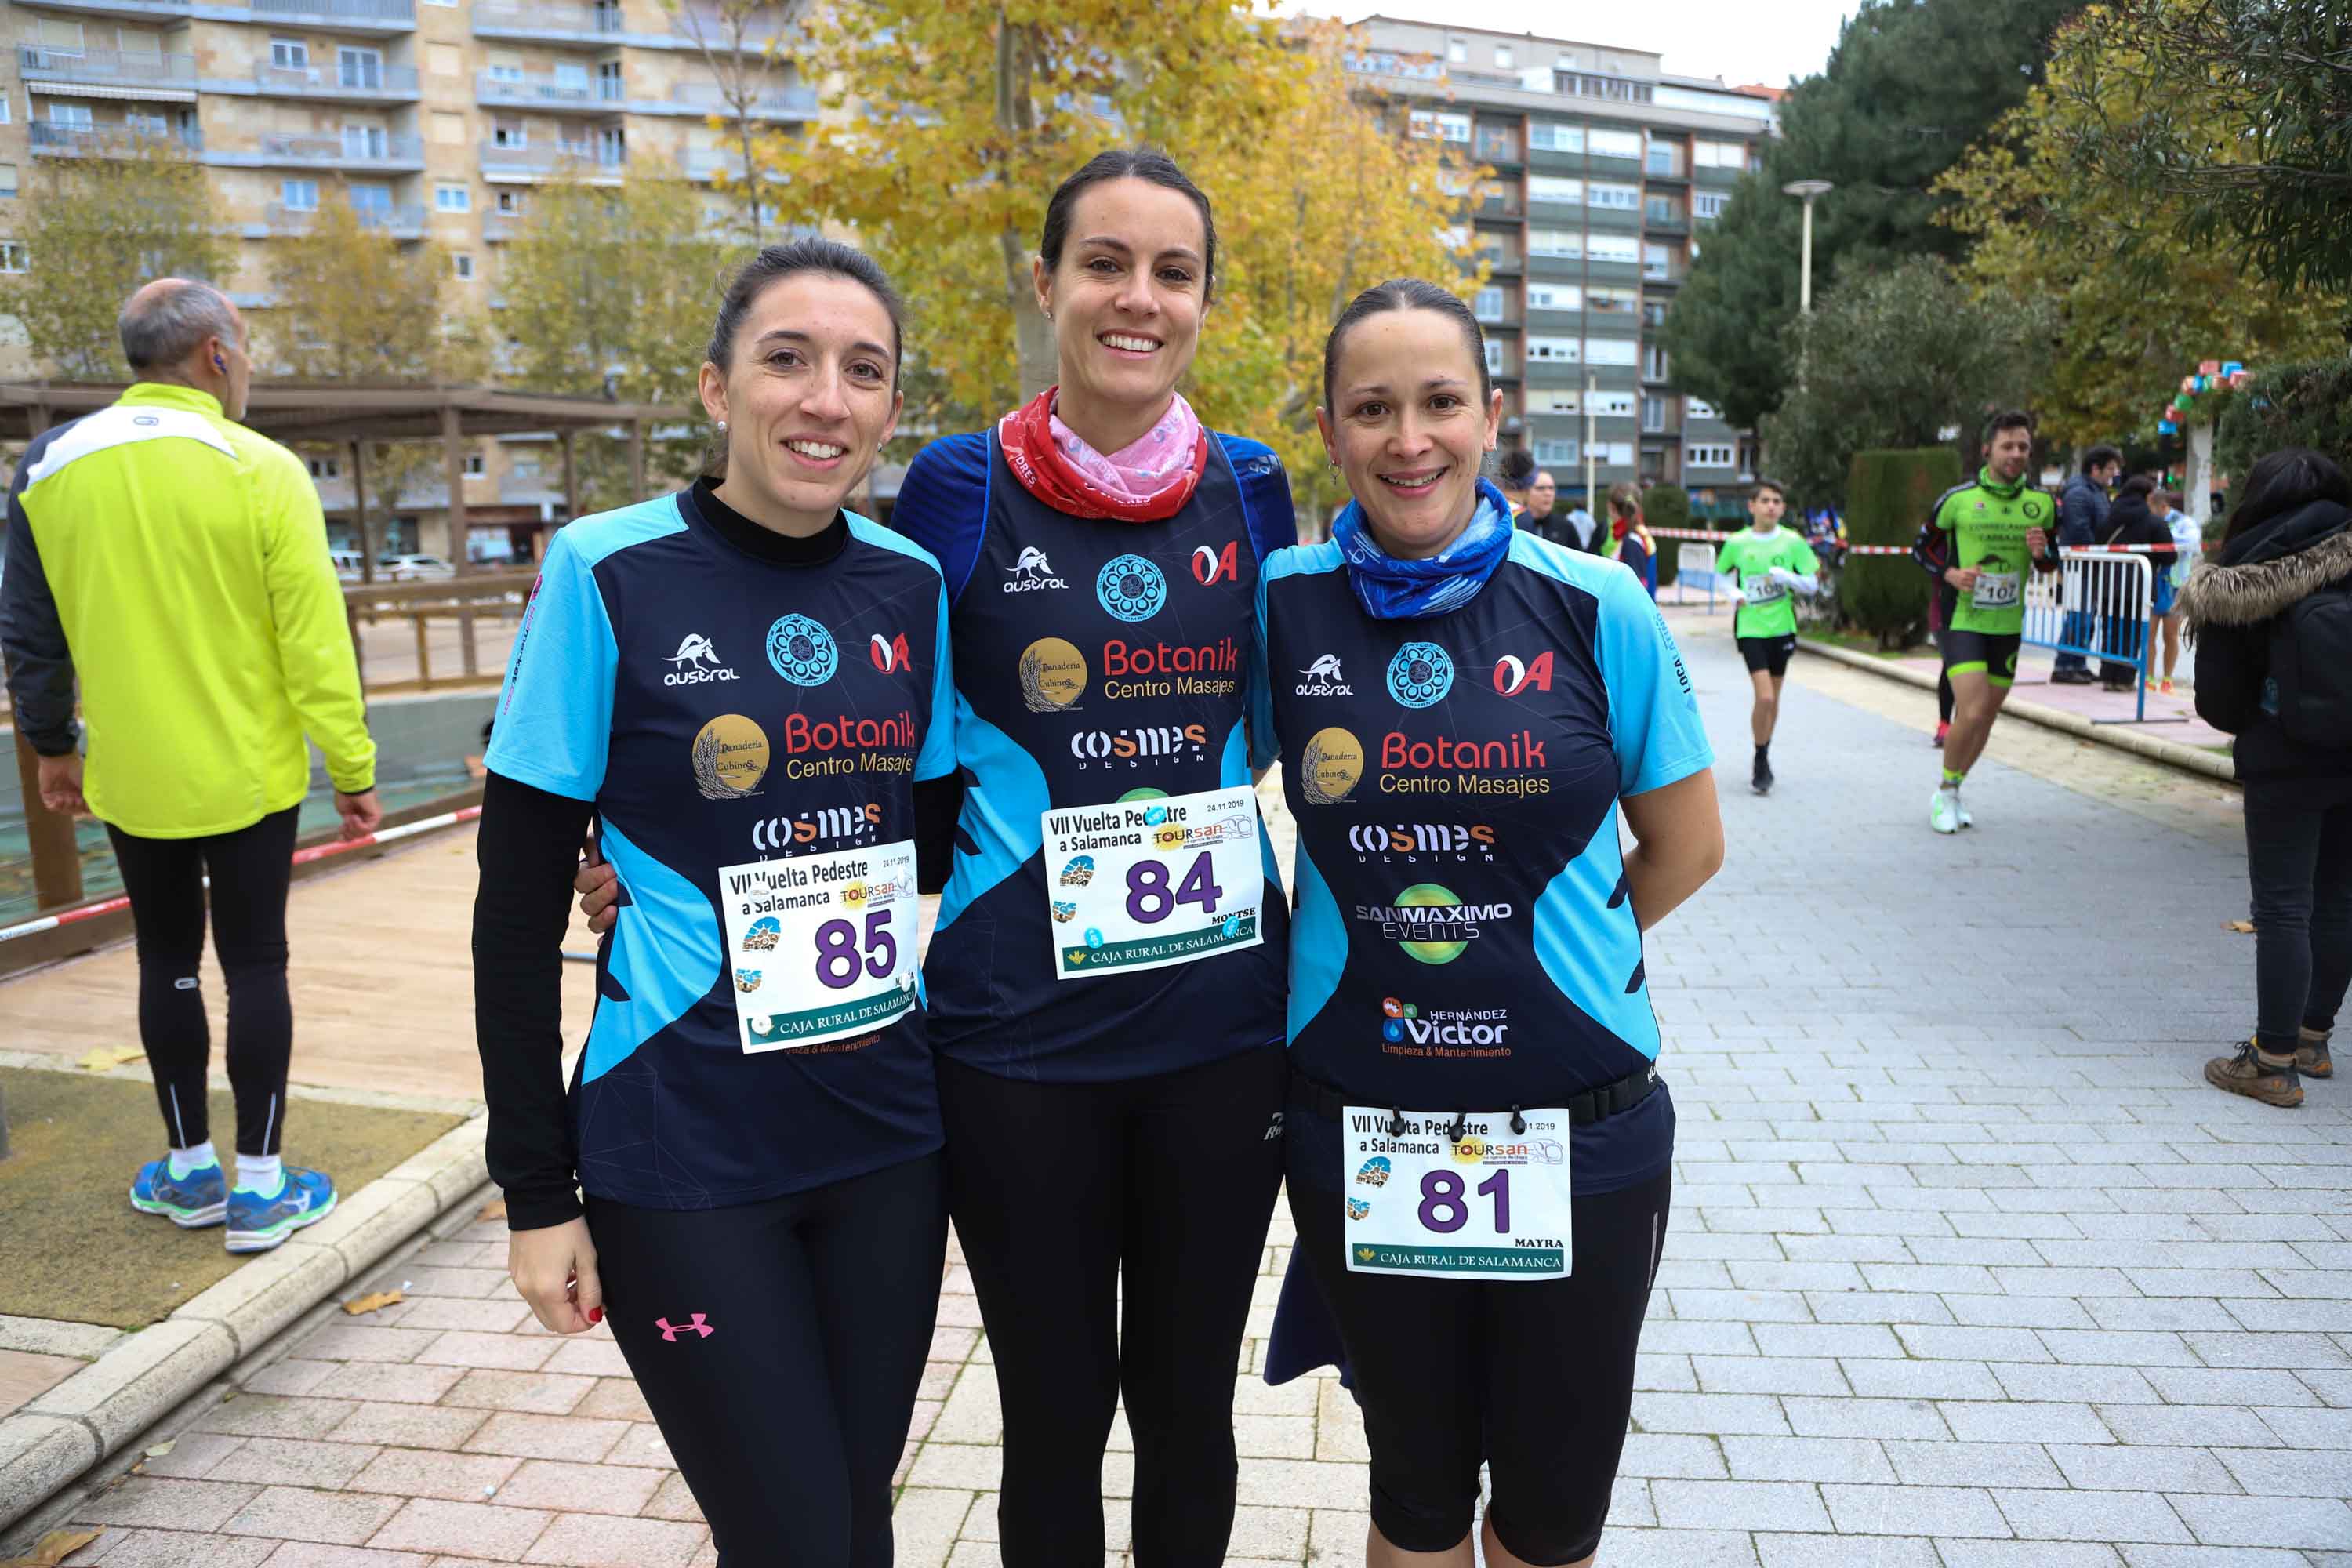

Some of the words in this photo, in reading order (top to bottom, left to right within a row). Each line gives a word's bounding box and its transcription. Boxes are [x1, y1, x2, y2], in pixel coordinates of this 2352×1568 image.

[1004, 576, 1069, 593] austral
[1104, 637, 1238, 676] Botanik
[664, 667, 740, 687] austral
[1105, 677, 1171, 699] Centro
[1177, 677, 1235, 698] Masajes
[1295, 679, 1354, 697] austral
[785, 710, 916, 753] Botanik
[1079, 753, 1205, 770] DESIGN
[1381, 730, 1547, 770] Botanik
[786, 757, 854, 780] Centro
[860, 753, 913, 775] Masaje
[1380, 774, 1452, 794] Centro
[1458, 775, 1550, 798] Masajes
[1049, 816, 1070, 835] VII
[1073, 811, 1121, 832] Vuelta
[1125, 806, 1187, 828] Petre
[1207, 799, 1244, 812] 24.11.2019
[1059, 840, 1067, 852] a
[1071, 832, 1142, 851] Salamanca
[1359, 854, 1494, 863] DESIGN
[729, 873, 752, 895] VII
[812, 859, 869, 884] Pedestre
[1126, 851, 1223, 924] 84
[742, 902, 750, 915] a
[755, 891, 830, 913] Salamanca
[815, 909, 897, 989] 85
[1091, 950, 1123, 964] CAJA
[1126, 943, 1167, 960] RURAL
[1169, 940, 1184, 953] DE
[1186, 925, 1254, 950] SALAMNCA
[780, 1021, 815, 1035] CAJA
[817, 1009, 858, 1029] RURAL
[859, 1004, 873, 1019] DE
[1430, 1008, 1508, 1021] HERNÁNDEZ
[1381, 1044, 1424, 1056] Limpieza
[1426, 1047, 1432, 1056] &
[1435, 1046, 1512, 1058] Mantenimiento
[1352, 1115, 1370, 1133] VII
[1374, 1116, 1421, 1135] Vuta
[1425, 1119, 1488, 1136] Pedstre
[1359, 1142, 1367, 1152] a
[1371, 1138, 1439, 1154] Salamanca
[1417, 1168, 1510, 1234] 81
[1515, 1238, 1563, 1248] MAYRA
[1380, 1253, 1410, 1265] CAJA
[1414, 1254, 1456, 1266] RURAL
[1458, 1256, 1475, 1266] DE
[1479, 1256, 1561, 1269] SALAMANCA
